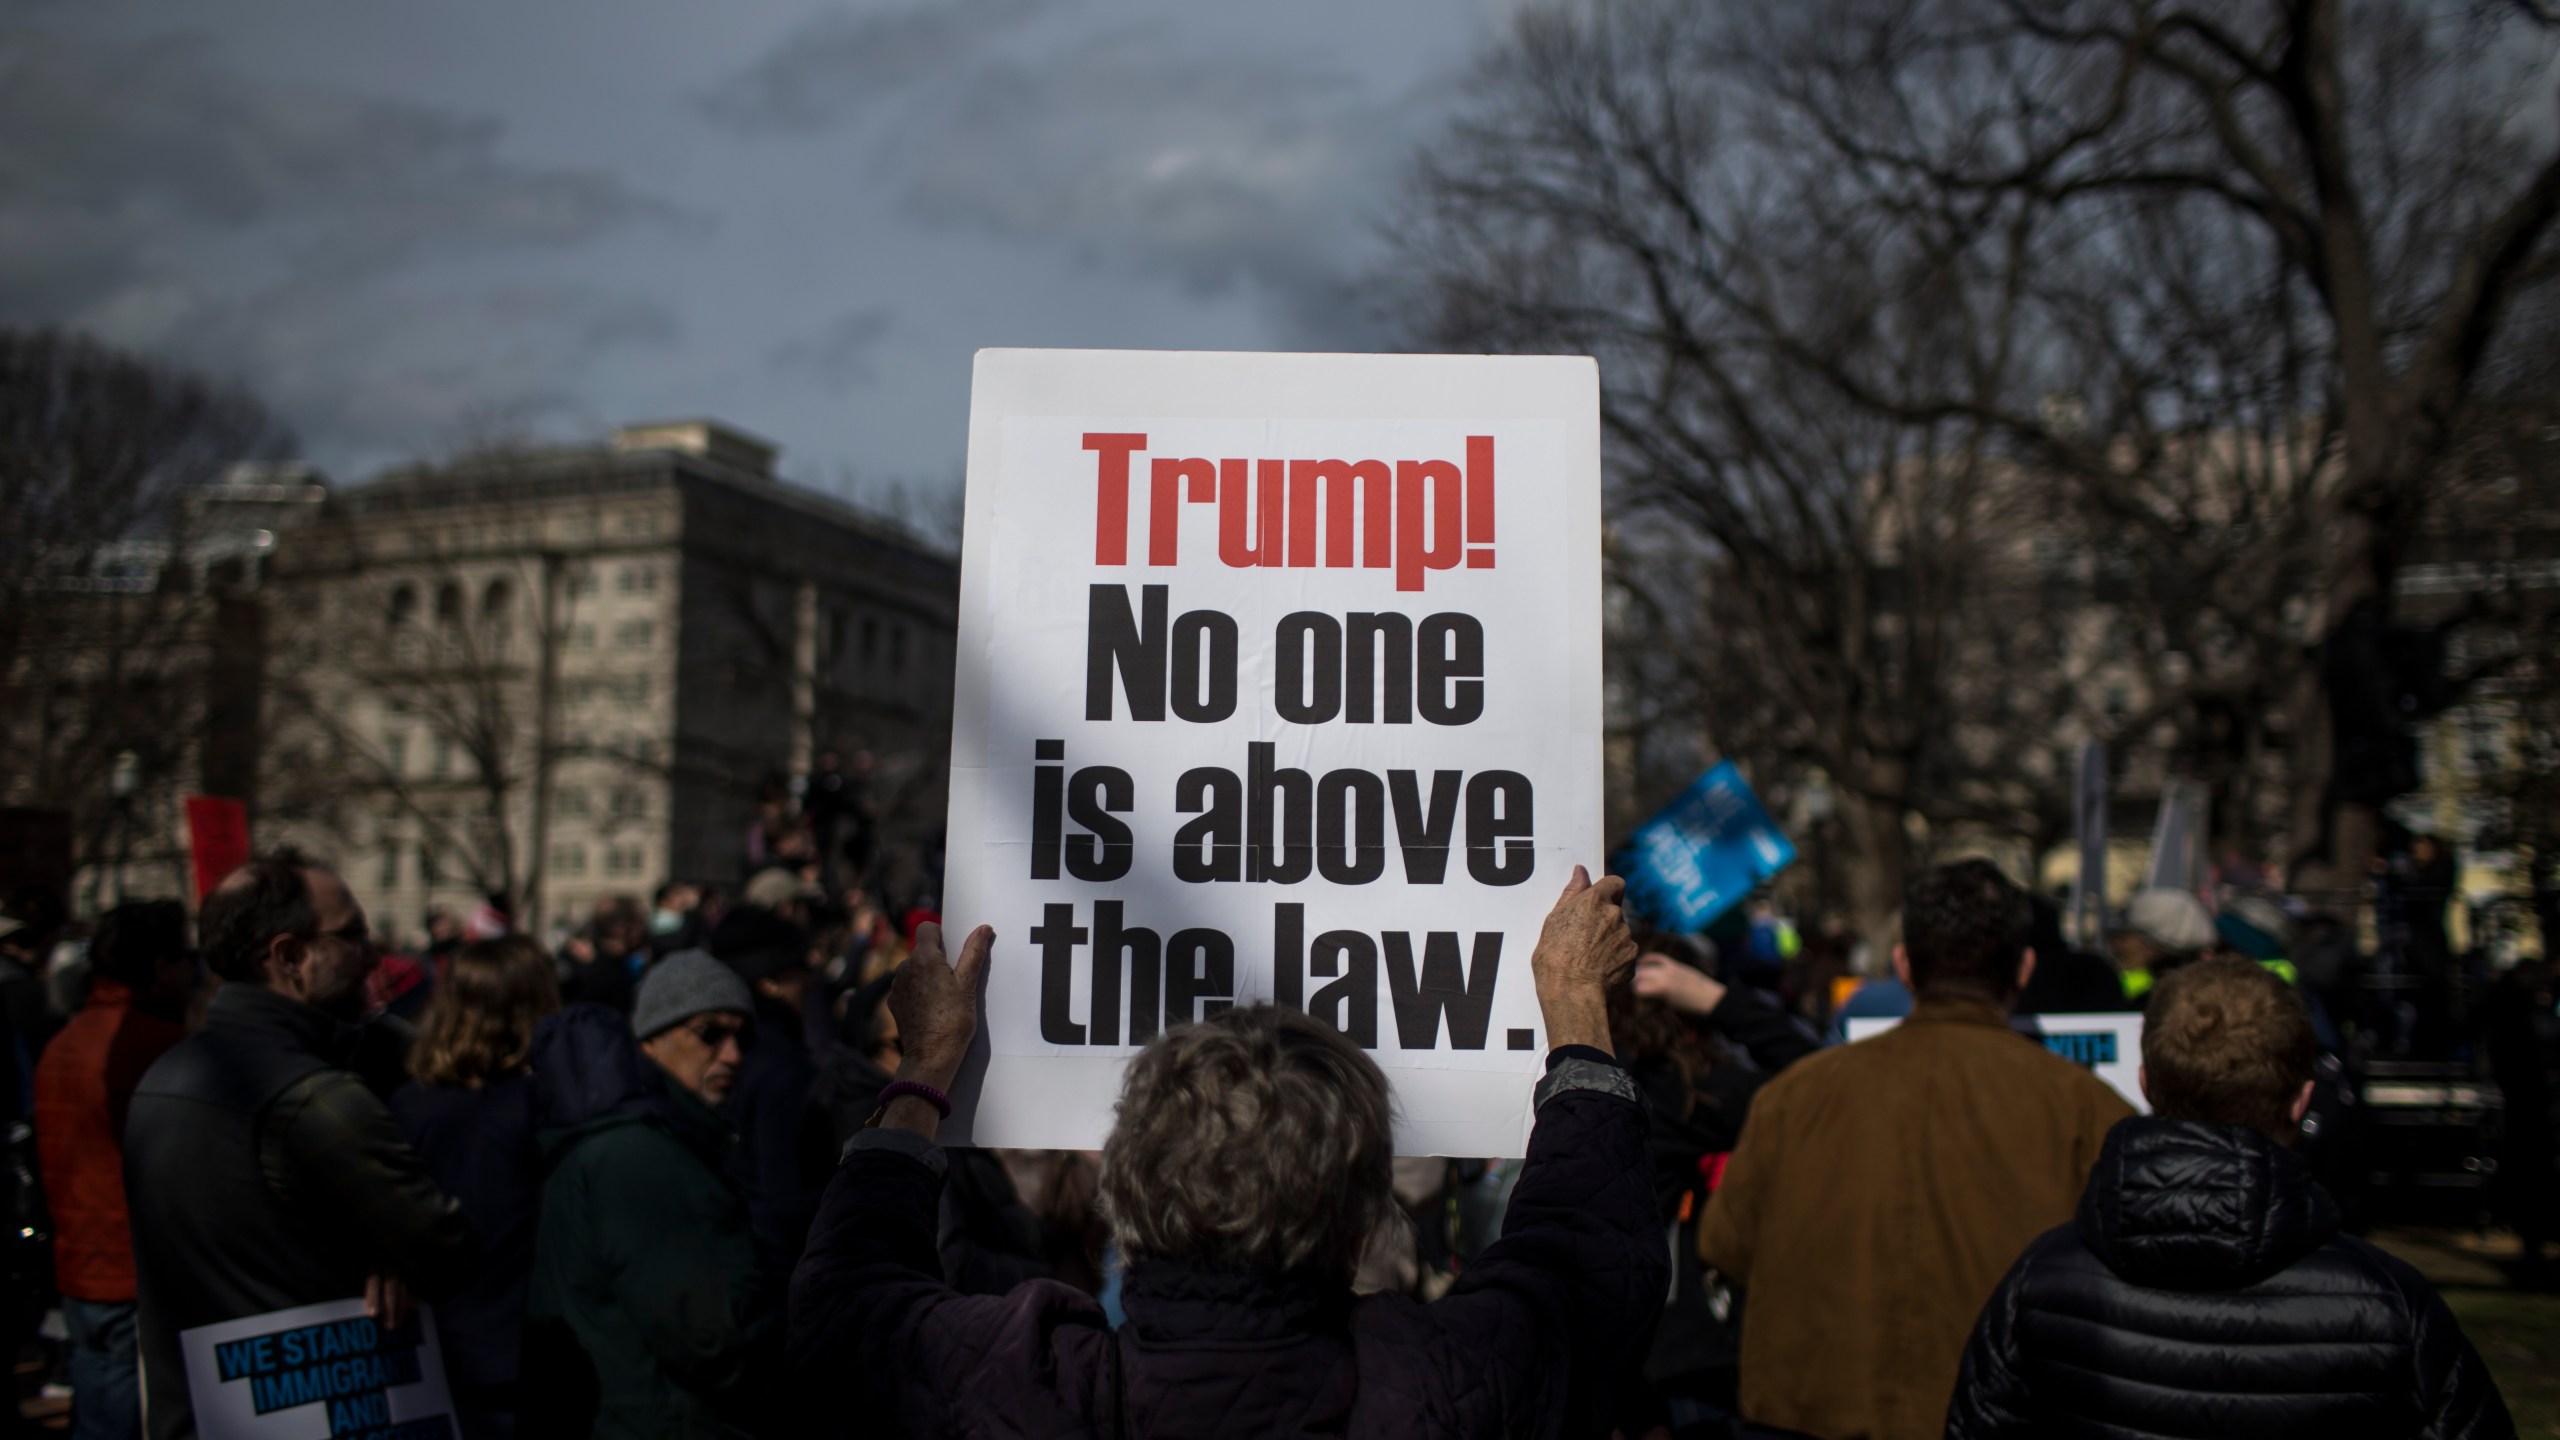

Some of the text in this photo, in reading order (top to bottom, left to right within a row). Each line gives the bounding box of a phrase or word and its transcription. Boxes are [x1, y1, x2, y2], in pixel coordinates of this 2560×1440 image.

[1083, 433, 1495, 591] Trump!
[1086, 584, 1484, 726] No one
[1031, 739, 1134, 882] is
[1173, 741, 1534, 886] above
[1030, 900, 1534, 1051] the law.
[218, 1335, 278, 1381] WE
[280, 1317, 379, 1366] STAND
[331, 1390, 390, 1434] AND
